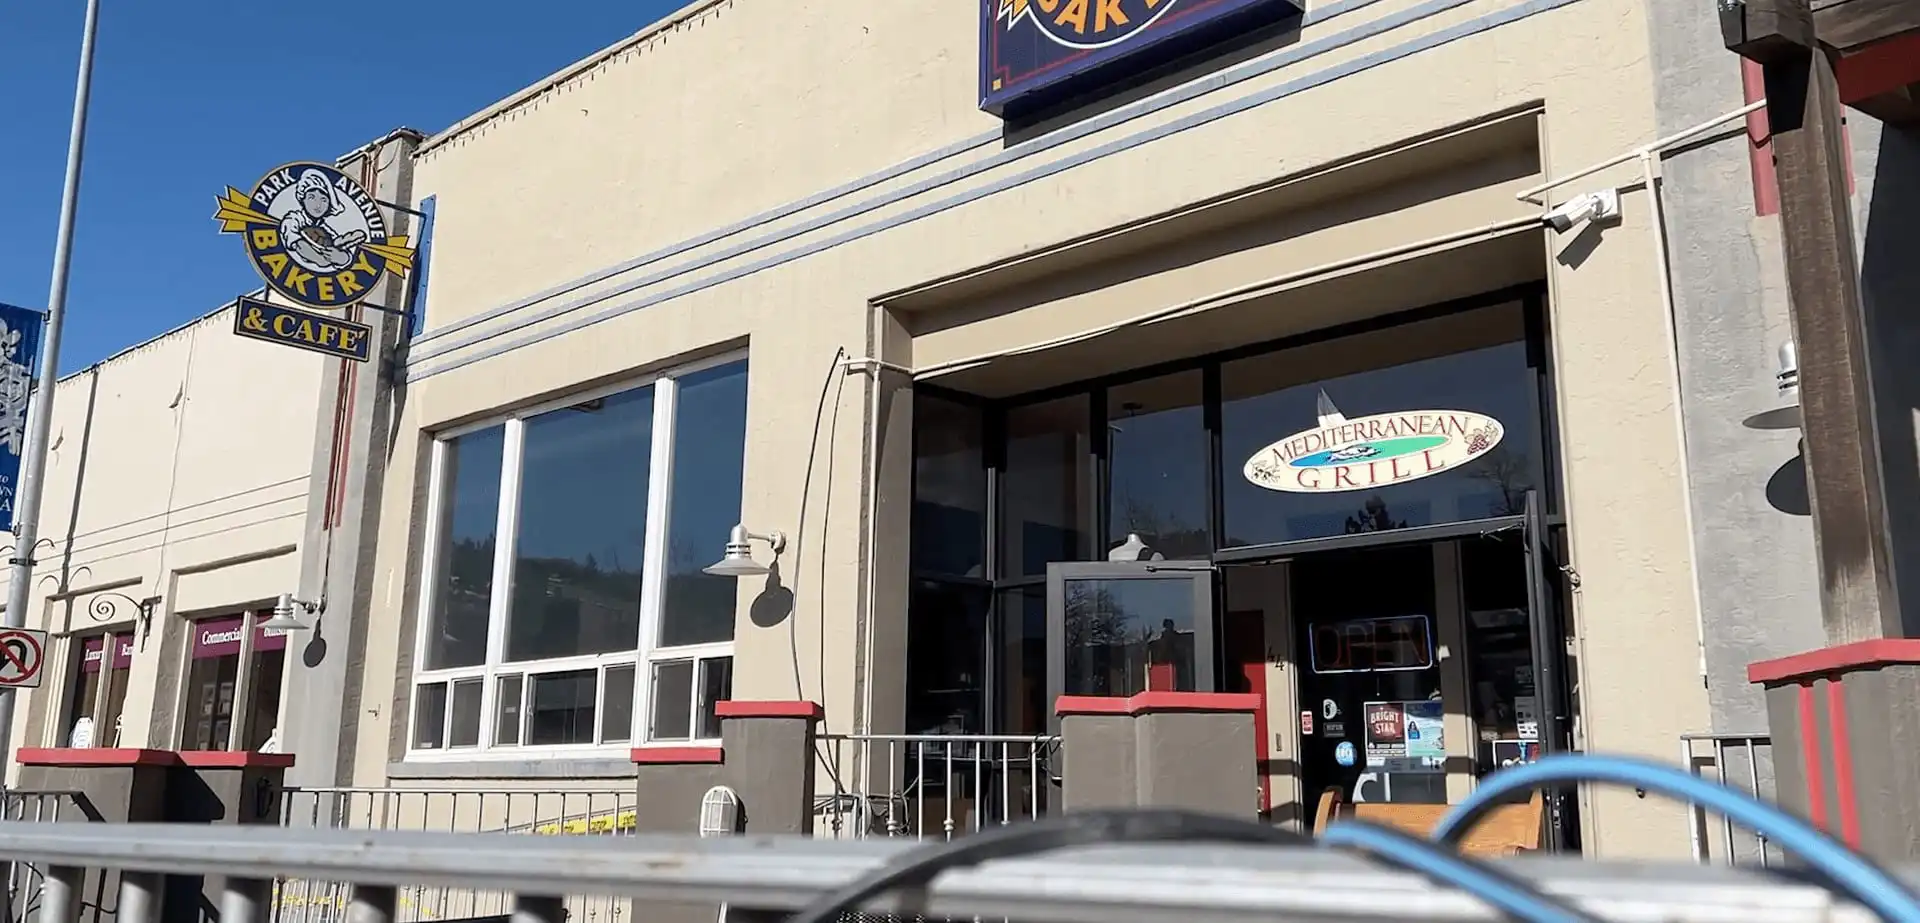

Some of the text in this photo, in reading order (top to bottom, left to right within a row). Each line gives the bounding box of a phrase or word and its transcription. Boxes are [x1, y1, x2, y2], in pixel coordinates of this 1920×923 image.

[254, 167, 385, 240] PARK AVENUE
[252, 228, 378, 301] BAKERY
[243, 307, 268, 333] &
[1271, 415, 1471, 462] MEDITERRANEAN
[1297, 449, 1445, 490] GRILL
[1266, 645, 1285, 672] 44
[1316, 620, 1427, 668] OPEN
[1370, 710, 1400, 724] BRIGHT
[1375, 722, 1396, 734] STAR
